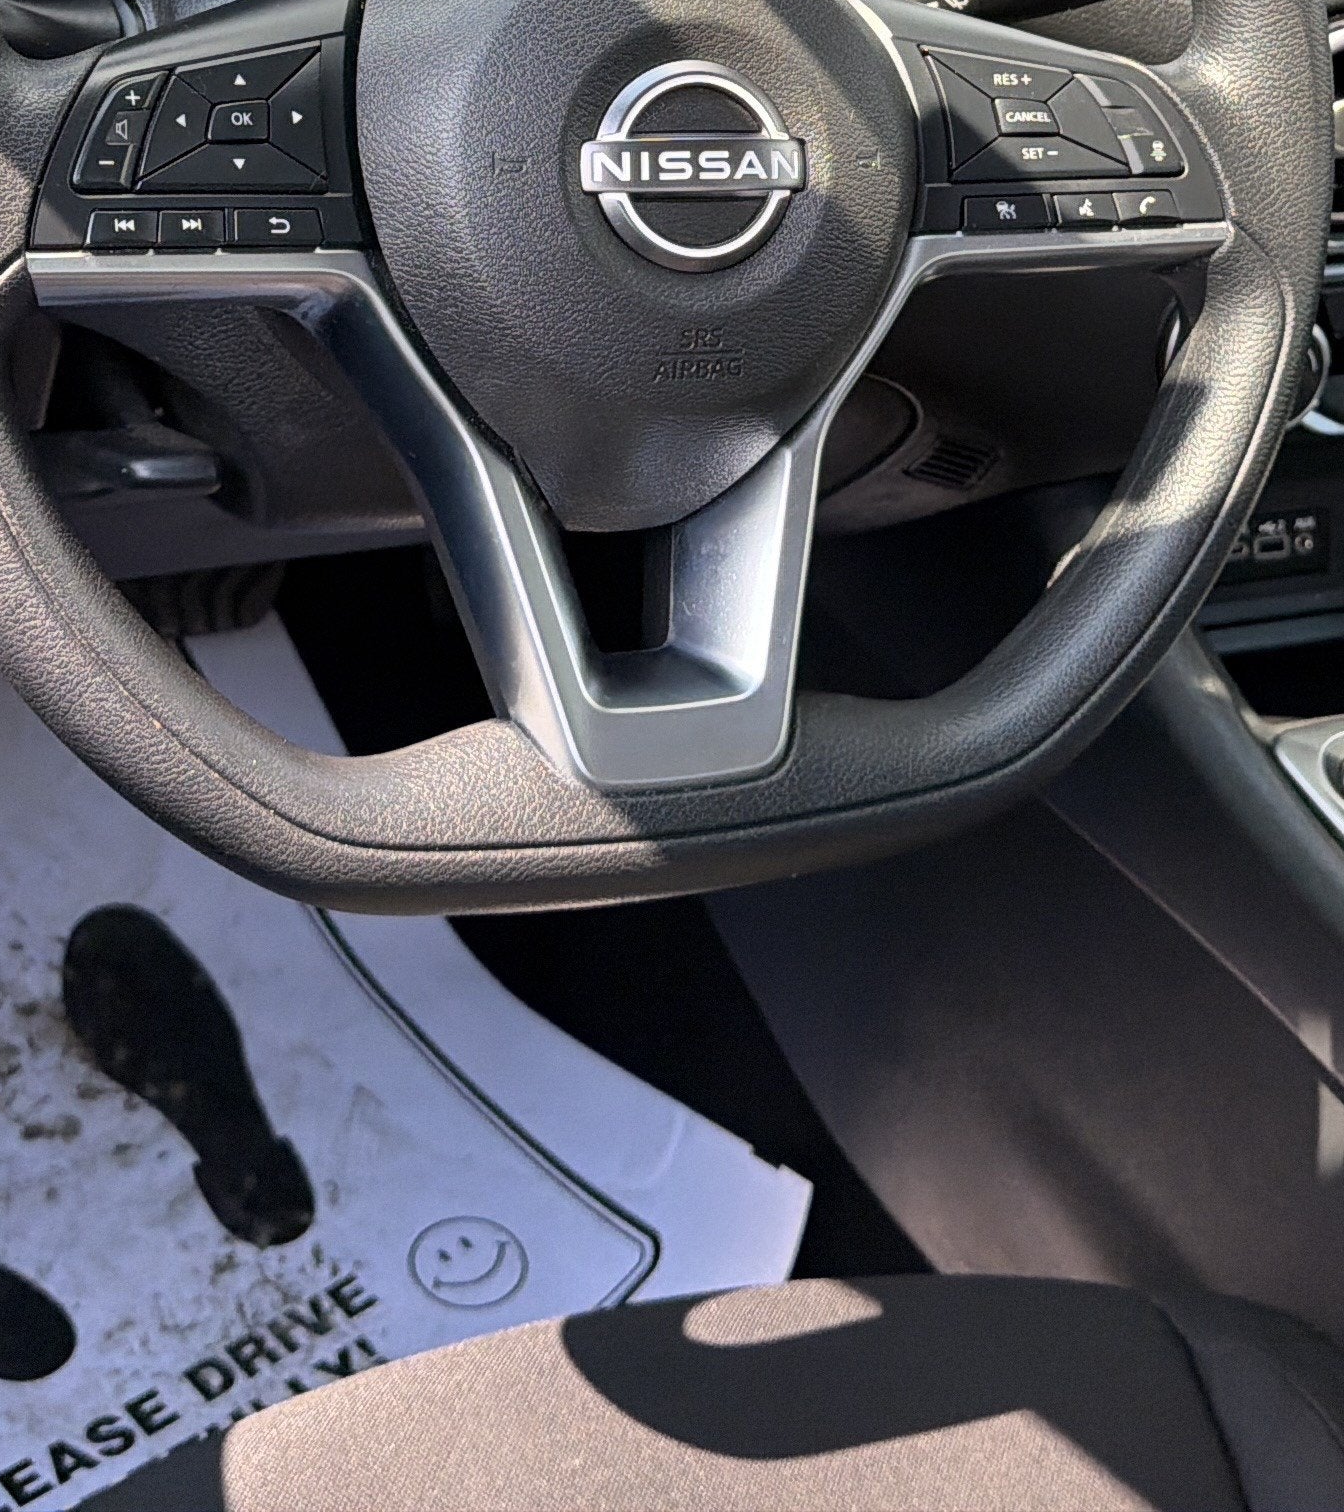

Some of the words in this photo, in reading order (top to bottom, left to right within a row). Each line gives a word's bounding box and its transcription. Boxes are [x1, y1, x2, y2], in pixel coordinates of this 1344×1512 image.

[993, 73, 1018, 86] RES
[231, 112, 254, 126] OK
[1005, 111, 1051, 123] CANCEL
[1021, 147, 1044, 160] SET
[592, 150, 800, 183] NISSAN
[680, 327, 724, 350] SRS
[182, 1273, 380, 1402] DRIVE
